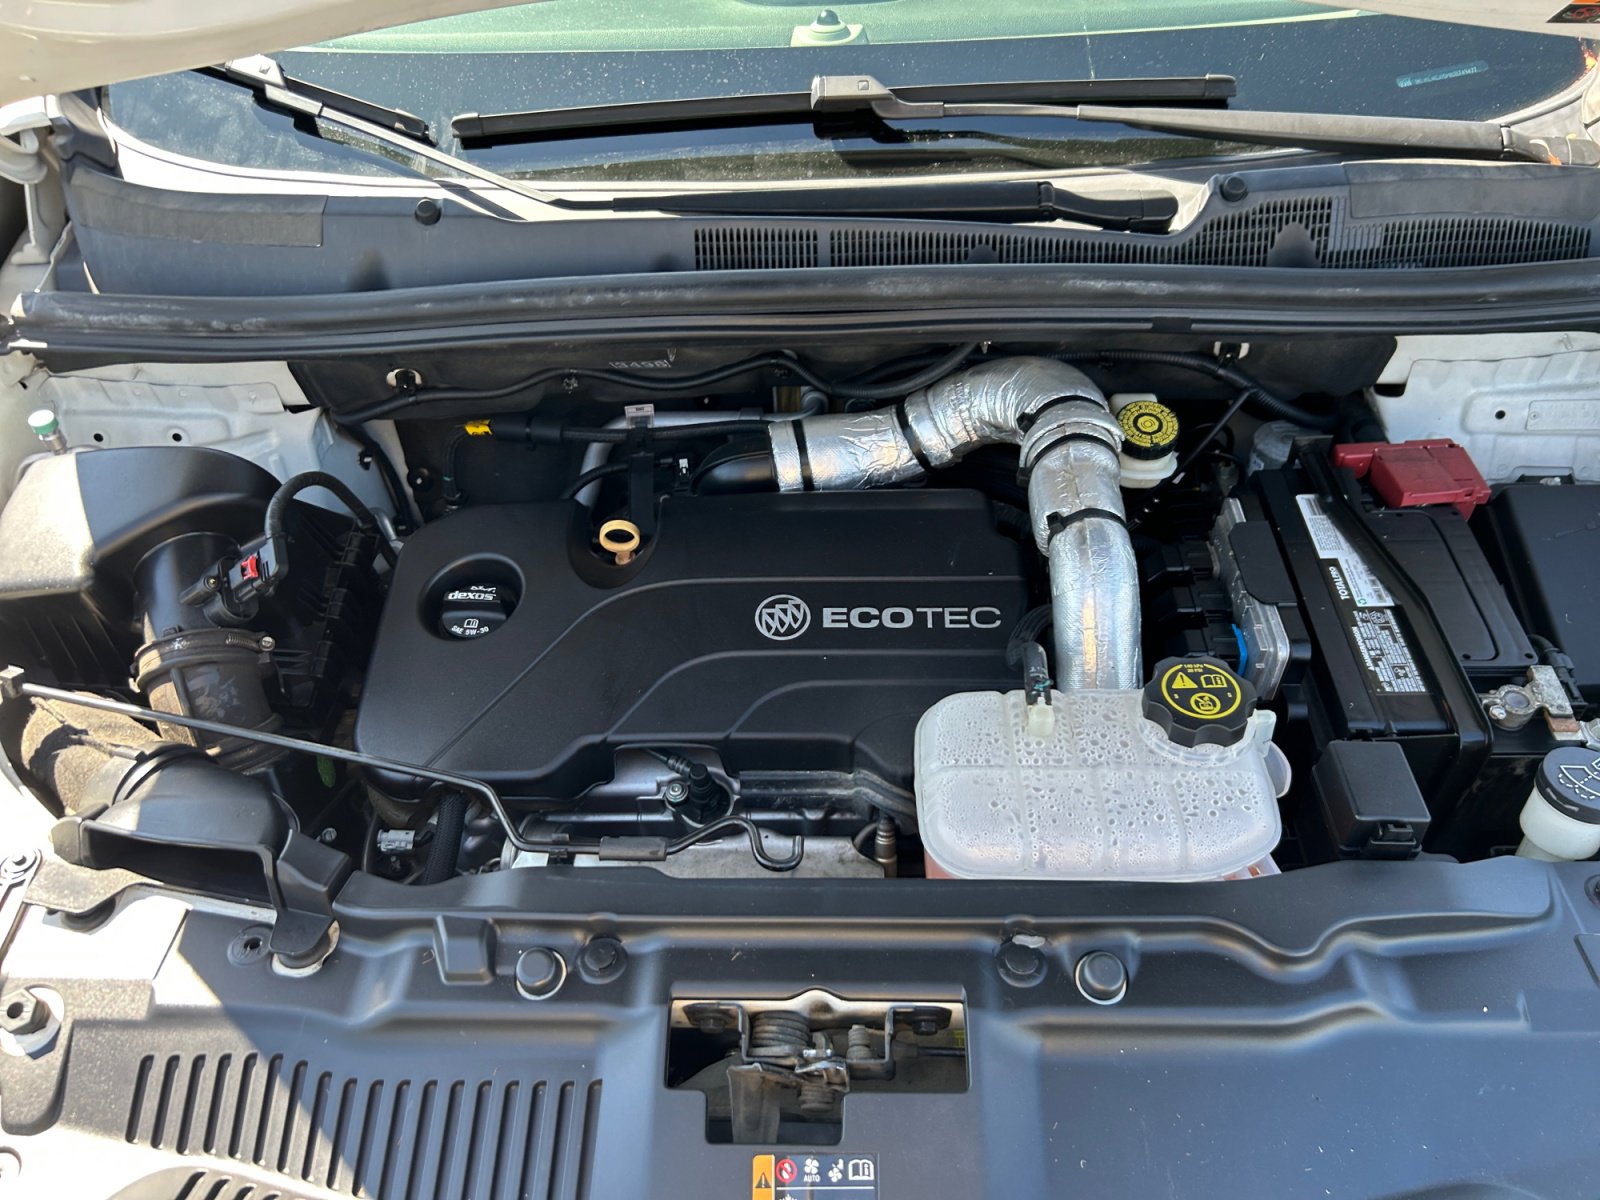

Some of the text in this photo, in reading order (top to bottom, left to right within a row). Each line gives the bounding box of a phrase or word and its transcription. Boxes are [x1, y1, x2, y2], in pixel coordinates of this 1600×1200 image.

[448, 590, 496, 601] dexos
[822, 607, 1002, 629] ECOTEC
[451, 625, 489, 635] SAE 5W-30
[803, 1174, 821, 1183] AUTO
